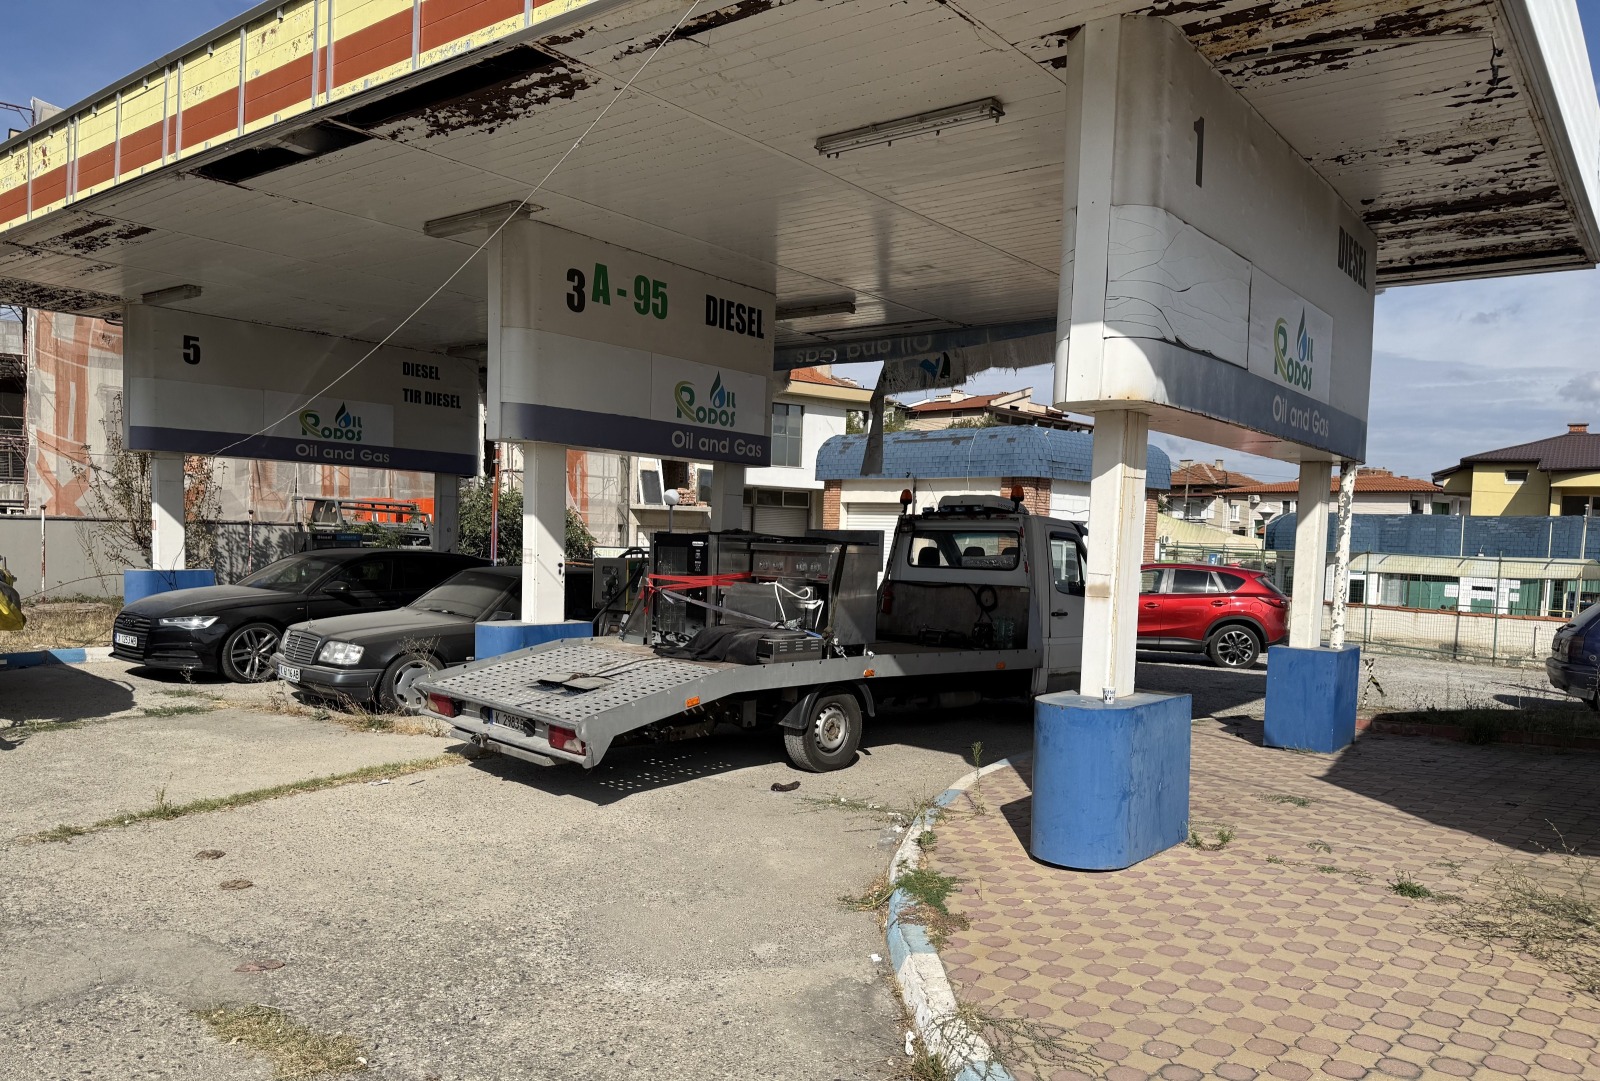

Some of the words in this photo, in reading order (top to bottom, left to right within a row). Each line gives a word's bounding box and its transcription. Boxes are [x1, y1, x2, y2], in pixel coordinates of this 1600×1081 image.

[1193, 116, 1205, 188] 1
[1338, 225, 1367, 289] DIESEL
[567, 268, 586, 313] 3
[705, 294, 765, 340] DIESEL
[183, 335, 200, 365] 5
[1273, 317, 1313, 391] RODOS
[402, 361, 440, 381] DIESEL
[402, 388, 422, 404] TIR
[424, 391, 461, 409] DIESEL
[674, 381, 736, 428] RODOS
[1272, 395, 1288, 423] Oil
[1289, 405, 1310, 431] and
[1311, 409, 1329, 438] Gas
[299, 409, 363, 442] RODOS
[671, 430, 694, 450] Oil
[698, 437, 729, 454] and
[733, 438, 762, 458] Gas
[295, 443, 318, 457] Oil
[322, 448, 355, 460] and
[360, 449, 390, 463] Gas
